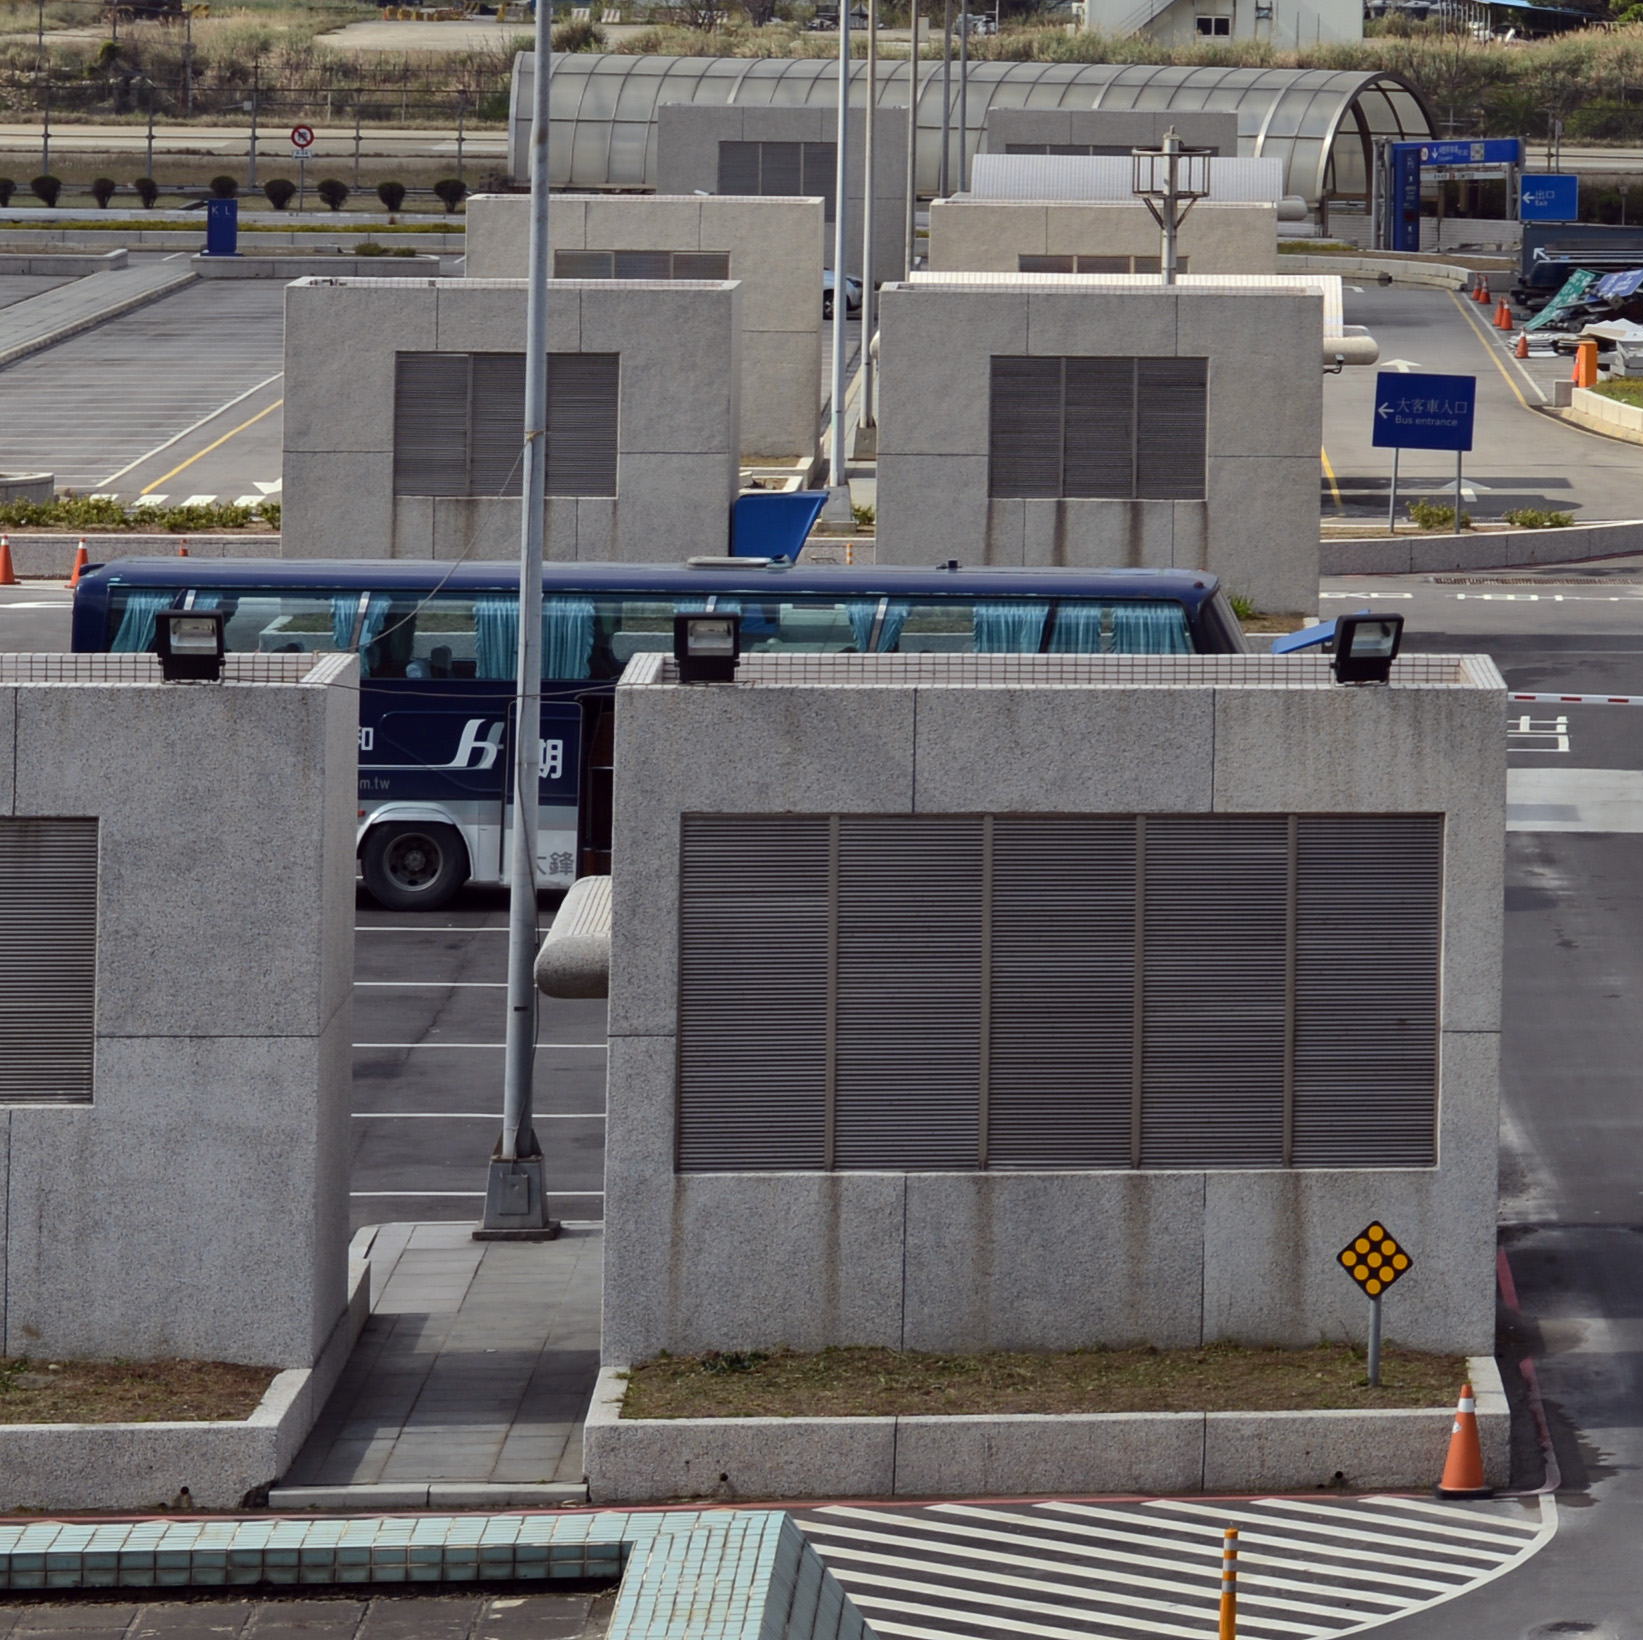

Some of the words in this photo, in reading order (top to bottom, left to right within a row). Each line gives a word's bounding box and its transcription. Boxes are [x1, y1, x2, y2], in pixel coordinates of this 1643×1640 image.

[211, 205, 219, 215] K
[225, 205, 231, 215] L
[1397, 398, 1468, 414] 大客車入口
[1395, 415, 1413, 424] Bus
[1415, 417, 1459, 427] entrance
